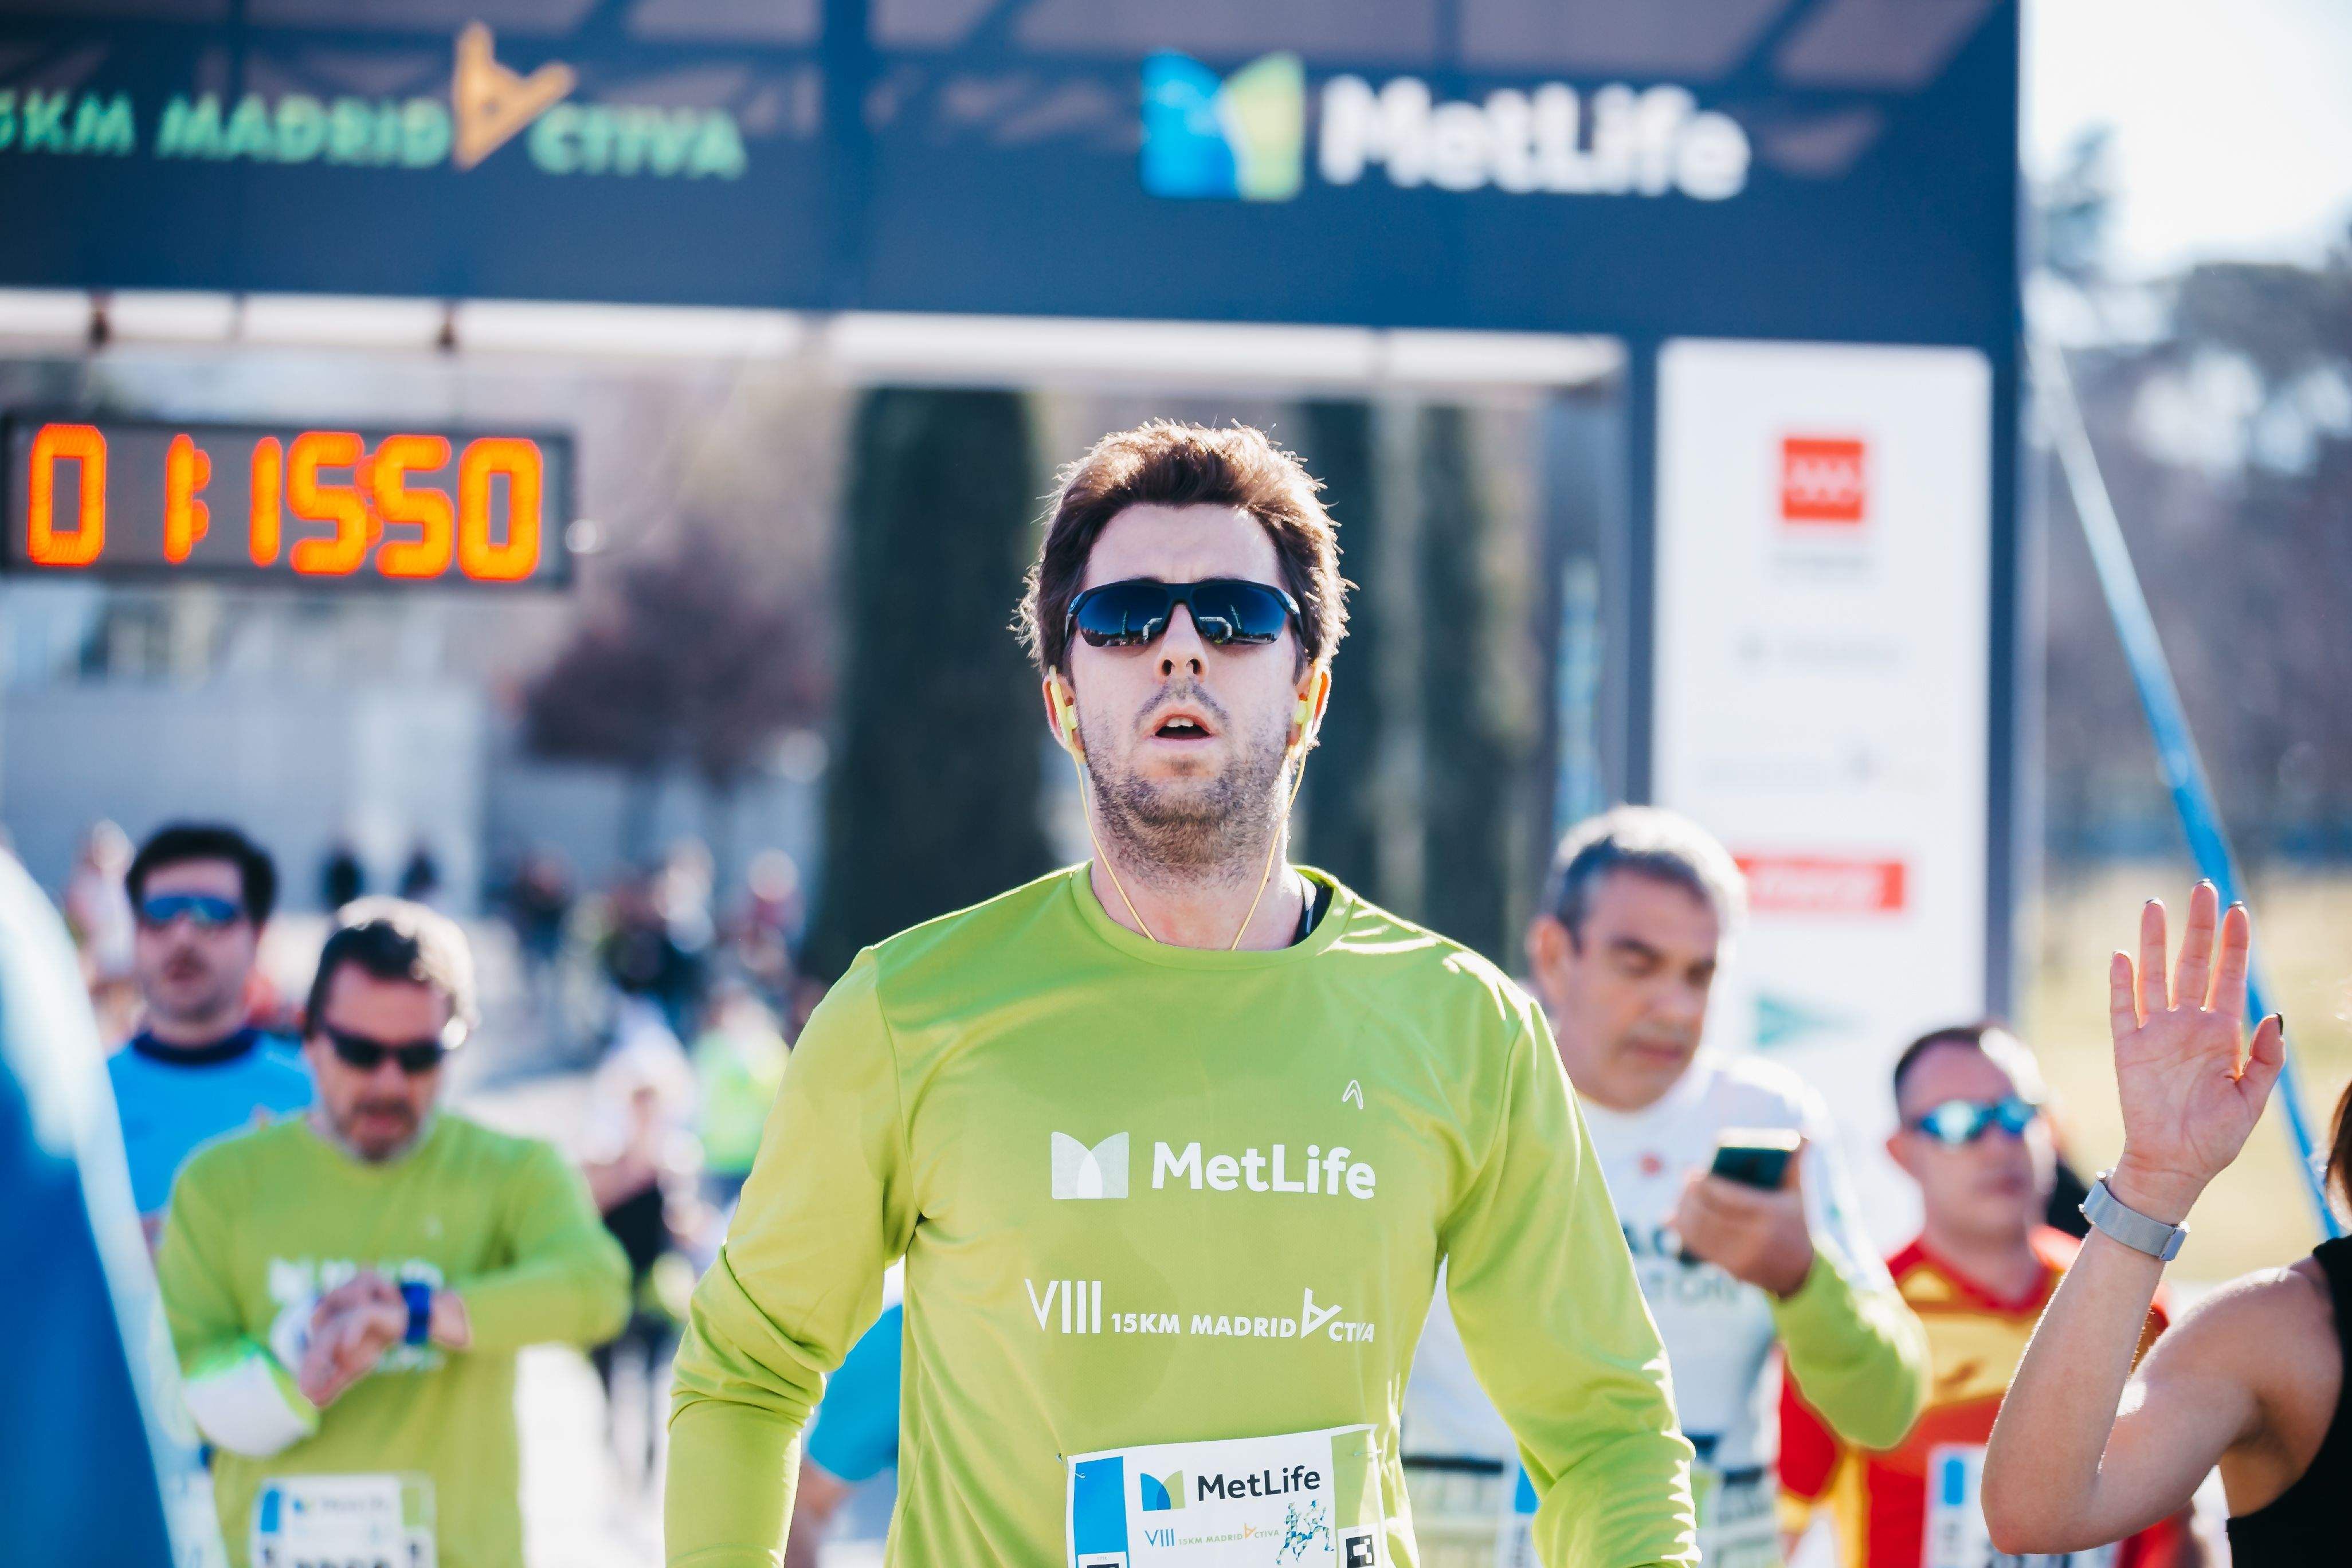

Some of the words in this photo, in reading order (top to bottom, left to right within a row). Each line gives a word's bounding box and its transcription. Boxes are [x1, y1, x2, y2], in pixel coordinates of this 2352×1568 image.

[155, 92, 452, 168] MADRID
[1320, 75, 1750, 201] MetLife
[1152, 1142, 1376, 1199] MetLife
[1025, 1278, 1102, 1334] VIII
[1111, 1313, 1180, 1334] 15KM
[1190, 1315, 1296, 1338] MADRID
[1198, 1465, 1320, 1501] MetLife
[1144, 1528, 1175, 1547] VIII
[1178, 1537, 1202, 1545] 15KM
[1206, 1534, 1242, 1543] MADRID
